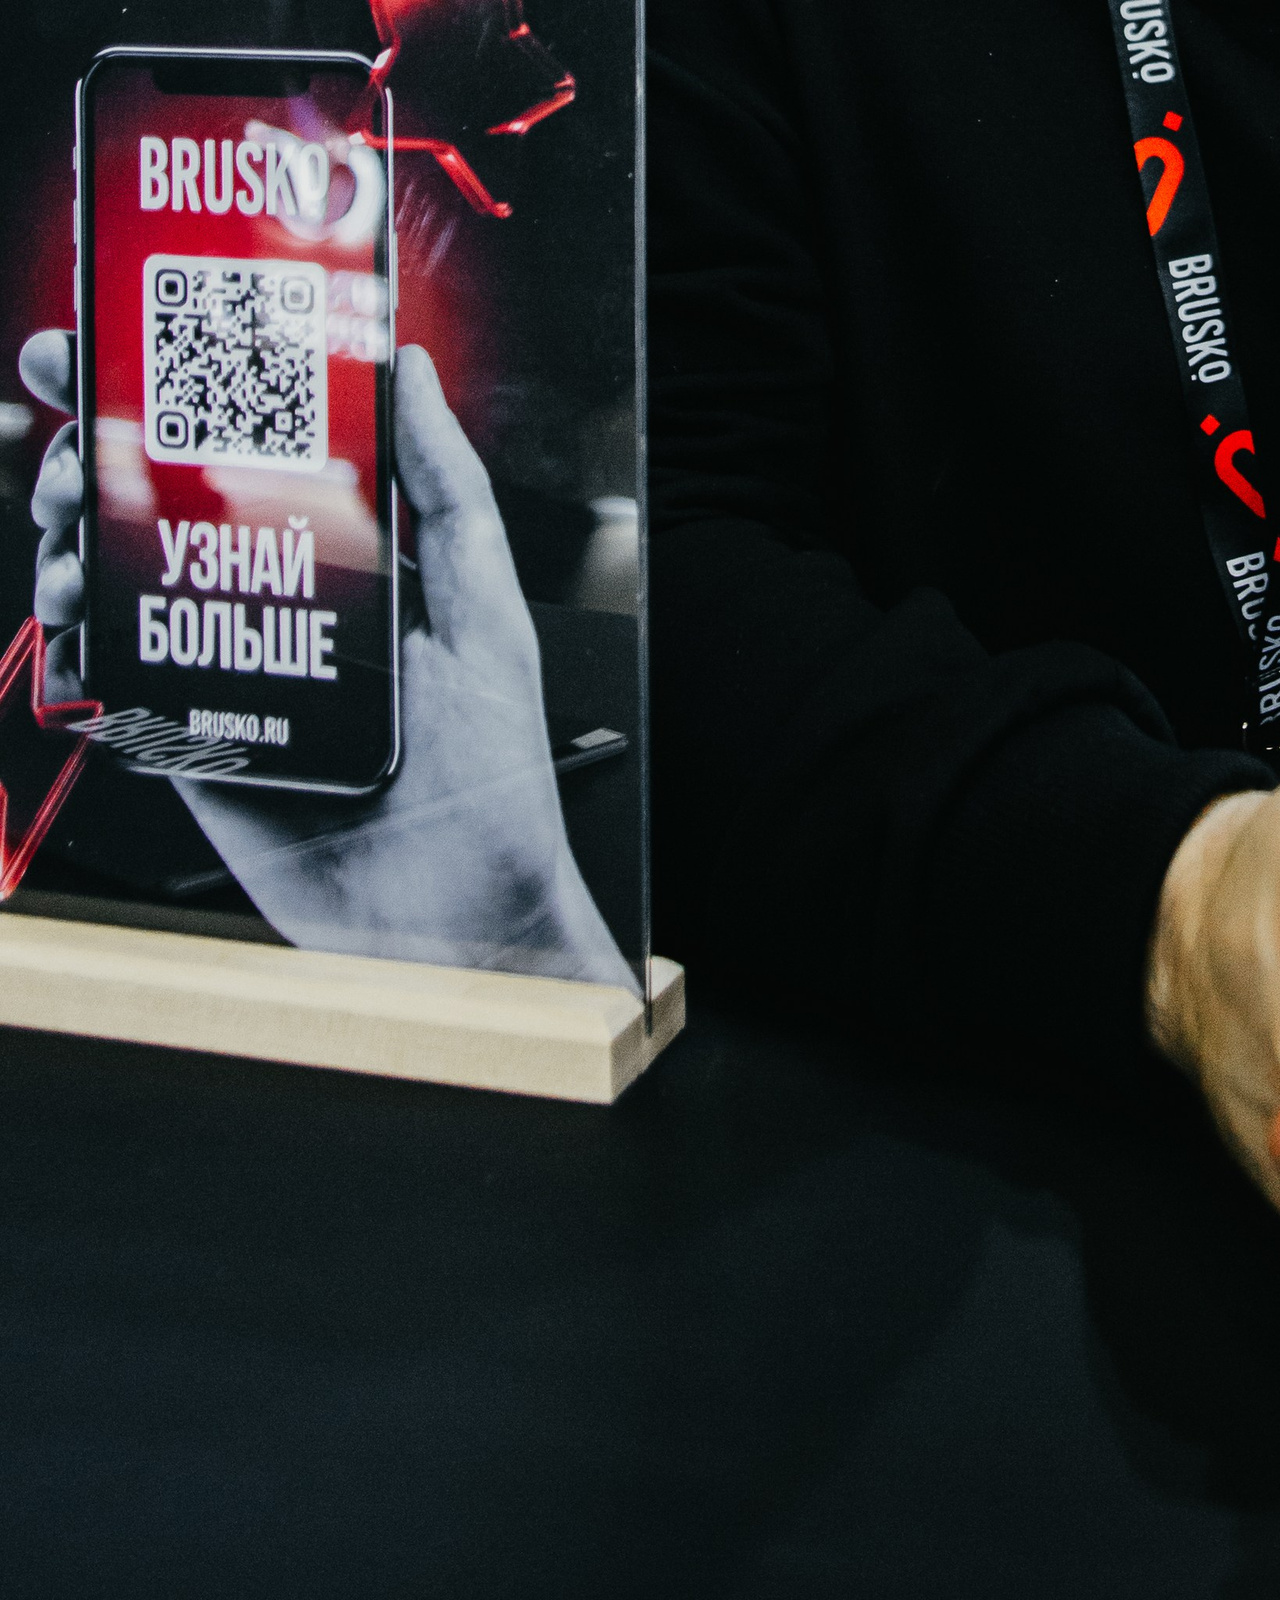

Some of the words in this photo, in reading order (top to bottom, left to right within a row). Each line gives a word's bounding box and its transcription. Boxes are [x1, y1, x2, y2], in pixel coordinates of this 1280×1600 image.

[139, 136, 329, 218] BRUSKO
[157, 516, 316, 599] УЗНАЙ
[138, 595, 339, 681] БОЛЬШЕ
[188, 708, 290, 746] BRUSKO.RU
